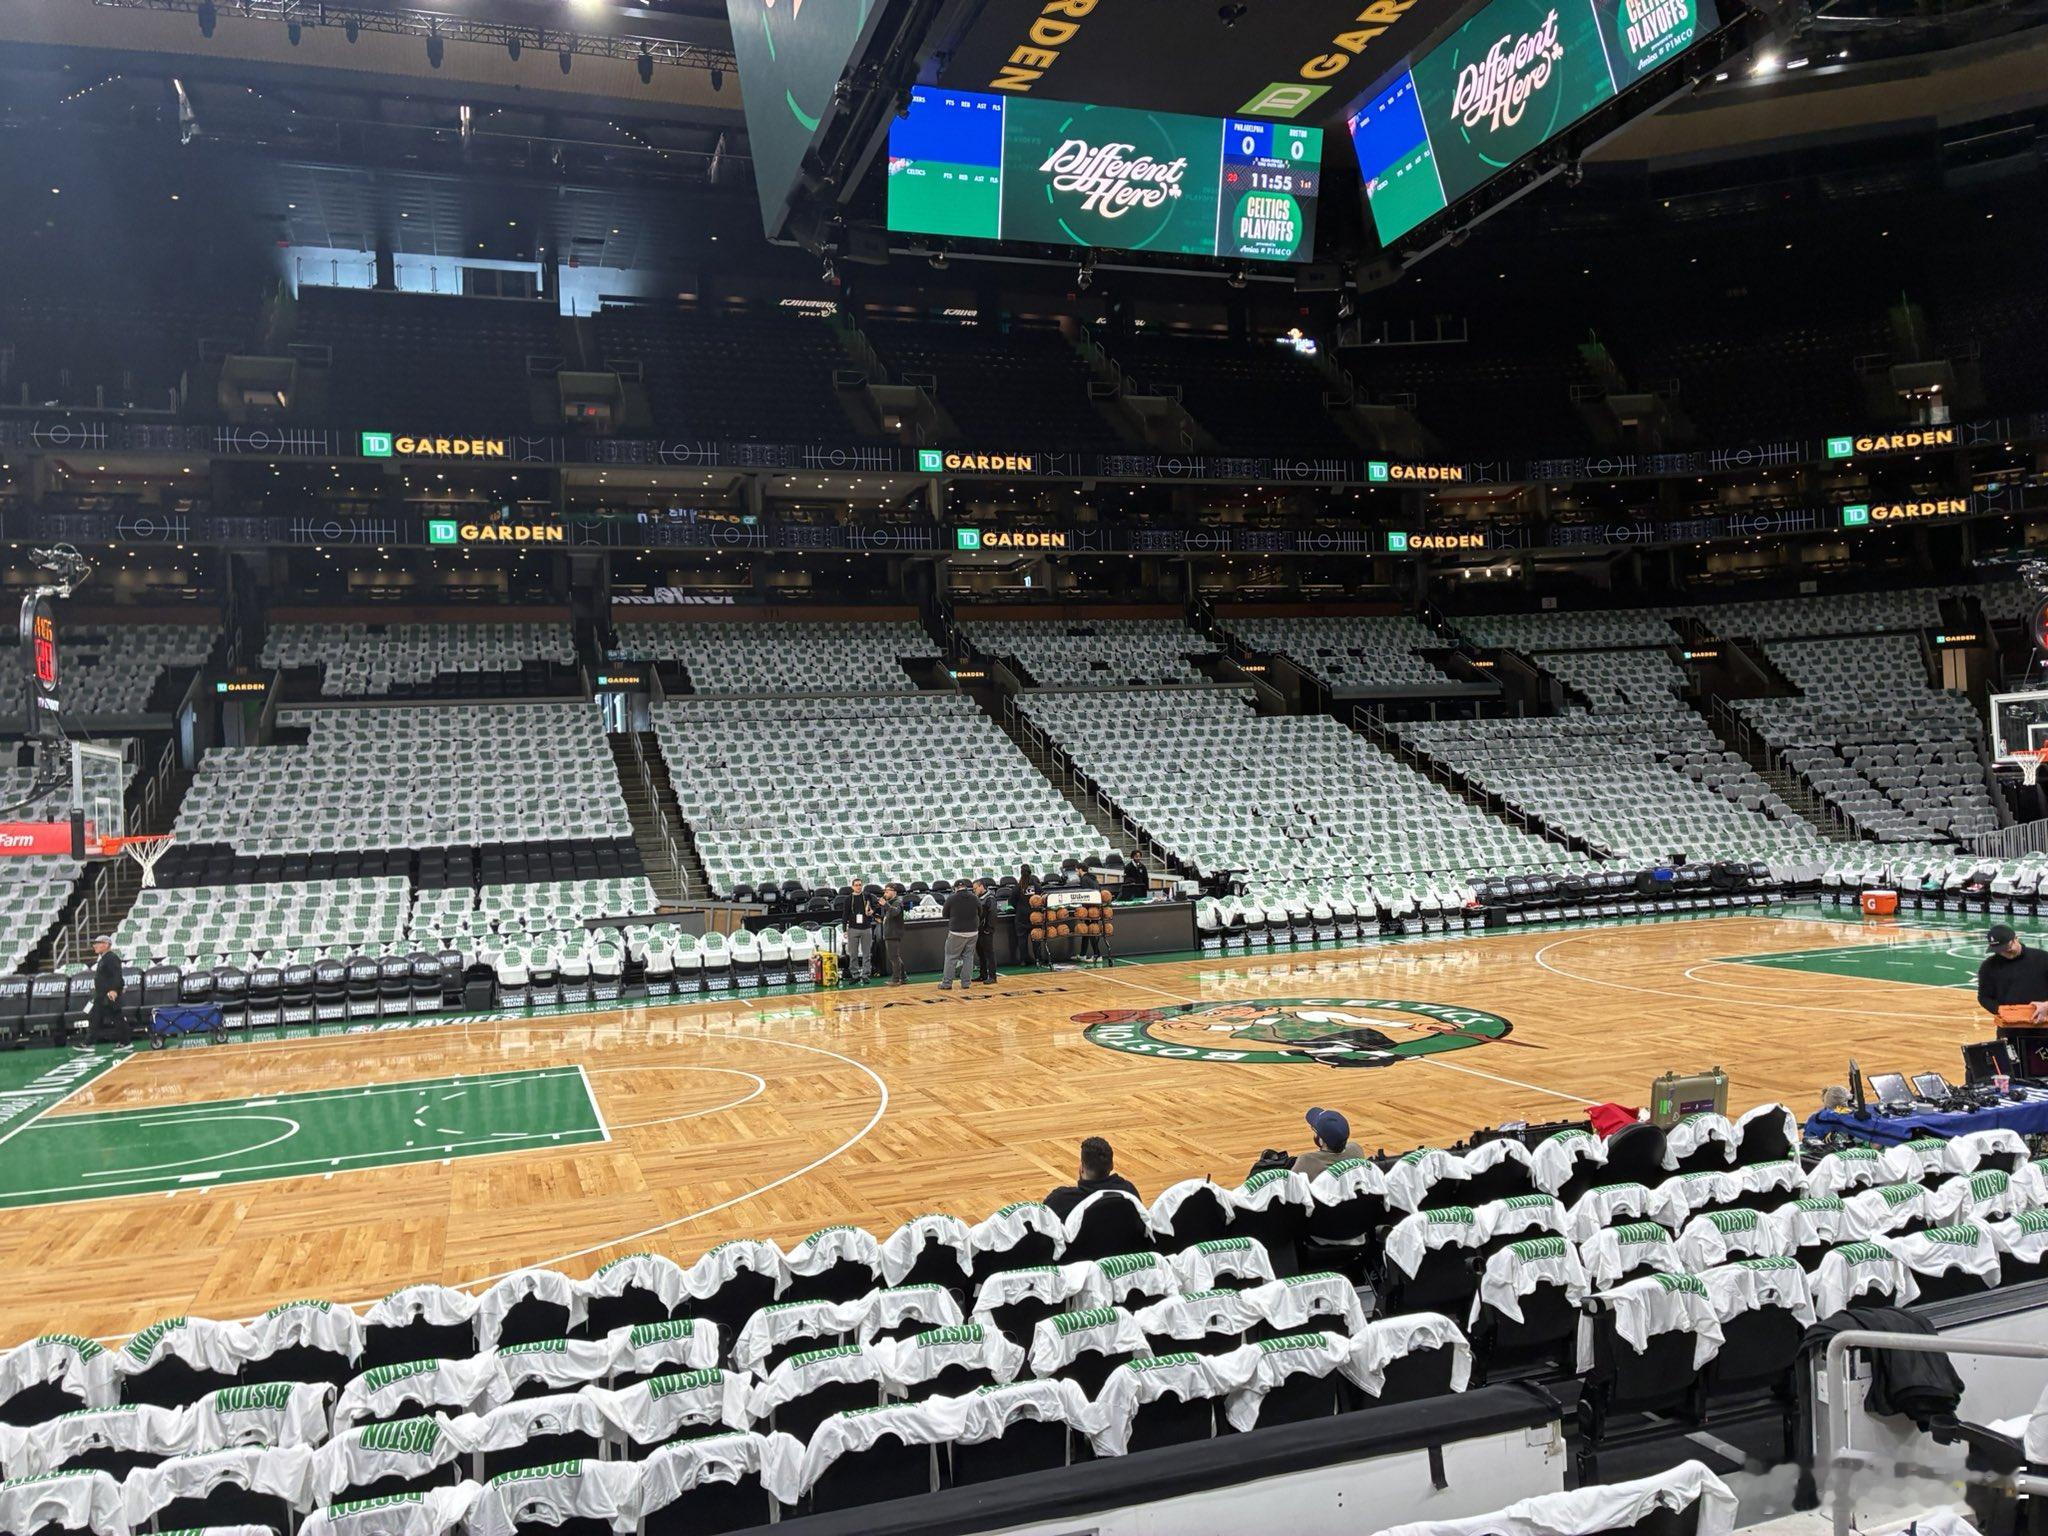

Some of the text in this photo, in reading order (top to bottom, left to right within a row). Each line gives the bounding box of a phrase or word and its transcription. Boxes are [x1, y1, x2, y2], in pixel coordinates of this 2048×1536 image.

[1627, 0, 1688, 53] PLAYOFFS
[1665, 29, 1693, 52] PIMCO
[1451, 10, 1558, 122] Different
[1485, 54, 1551, 133] Here
[1242, 136, 1255, 155] 0
[1291, 140, 1304, 160] 0
[1039, 139, 1187, 188] Different
[1251, 172, 1312, 191] 11:55 1st
[1070, 177, 1167, 219] Here
[1247, 197, 1291, 220] CELTICS
[1240, 217, 1294, 242] PLAYOFFS
[1266, 248, 1292, 256] PIMCO
[364, 434, 504, 456] TD GARDEN
[1829, 430, 1953, 455] TD GARDEN
[920, 452, 1032, 470] TD GARDEN
[1370, 464, 1462, 480] TD GARDEN
[1845, 499, 1966, 523] TD GARDEN
[431, 522, 563, 542] TD GARDEN
[959, 531, 1065, 548] TD GARDEN
[1390, 534, 1484, 549] TD GARDEN
[1945, 634, 1976, 642] GARDEN
[228, 682, 265, 691] GARDEN
[1867, 897, 1877, 910] G
[151, 971, 178, 984] PLAYOFFS
[255, 973, 279, 983] PLAYOFFS
[289, 969, 311, 979] PLAYOFFS
[354, 965, 377, 975] PLAYOFFS
[386, 962, 408, 972] PLAYOFFS
[418, 962, 440, 972] PLAYOFFS
[38, 982, 67, 993] PLAYOFFS
[376, 1012, 524, 1032] PLAYOFFS
[1302, 998, 1496, 1024] CELTICS
[1097, 1024, 1248, 1063] BOSTON
[1244, 1169, 1289, 1194] BOSTON
[1505, 1195, 1553, 1210] BOSTON
[1427, 1207, 1474, 1225] BOSTON
[1617, 1222, 1666, 1245] BOSTON
[1924, 1226, 1979, 1248] BOSTON
[1198, 1239, 1252, 1257] BOSTON
[1511, 1239, 1566, 1264] BOSTON
[1098, 1253, 1156, 1280] BOSTON
[1051, 1307, 1118, 1338] BOSTON
[124, 1316, 187, 1363] BOSTON
[630, 1320, 694, 1348] BOSTON
[917, 1325, 984, 1347] BOSTON
[1259, 1334, 1328, 1356] BOSTON
[365, 1360, 438, 1393] BOSTON
[648, 1369, 724, 1400] BOSTON
[215, 1383, 294, 1413] BOSTON
[361, 1419, 442, 1455] BOSTON
